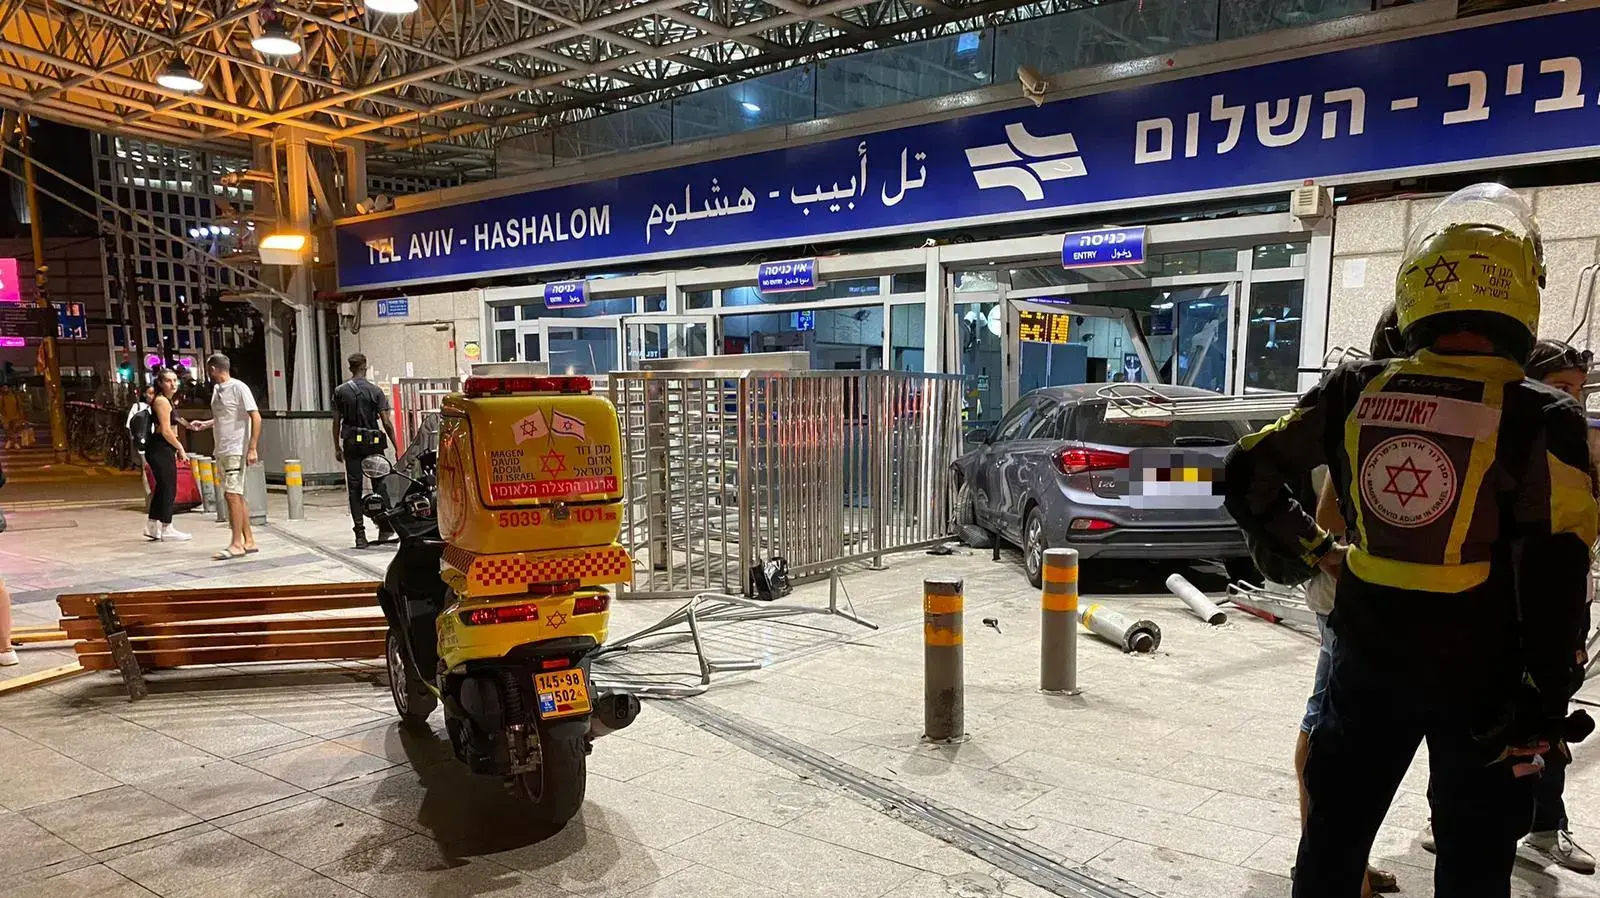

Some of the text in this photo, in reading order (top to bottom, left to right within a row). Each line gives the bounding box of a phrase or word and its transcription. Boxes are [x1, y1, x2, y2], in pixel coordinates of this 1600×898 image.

[1443, 56, 1600, 125] ביב
[1134, 86, 1366, 165] השלום
[790, 140, 868, 216] أبيب
[881, 146, 927, 207] تل
[646, 177, 756, 245] هشلوم
[365, 236, 401, 265] TEL
[408, 228, 454, 260] AVIV
[474, 204, 610, 252] HASHALOM
[1080, 232, 1127, 247] כניסה
[1073, 250, 1097, 260] ENTRY
[1111, 248, 1132, 259] دخول
[765, 263, 807, 276] אין כניסה
[1481, 264, 1497, 275] דוד
[552, 284, 576, 294] כניסה
[1489, 276, 1511, 289] אדום
[1473, 283, 1509, 300] בישראל
[1356, 396, 1439, 425] האופנועים
[490, 449, 524, 458] MAGEN
[576, 445, 611, 456] מגן דוד
[491, 458, 520, 466] DAVID
[587, 455, 612, 465] אדום
[1368, 441, 1448, 479] מגן דוד אדום בישראל
[492, 466, 521, 474] ADOM
[493, 473, 536, 482] IN ISRAEL
[573, 466, 613, 477] בישראל
[494, 480, 614, 497] ארגון ההצלה הלאומי
[1367, 479, 1380, 505] MAGEN
[1377, 503, 1398, 520] DAVID
[1423, 510, 1432, 518] IN
[1431, 490, 1449, 511] ISRAEL
[500, 511, 541, 528] 5039
[573, 508, 604, 523] 101
[539, 673, 579, 690] 145-98
[555, 689, 577, 703] 502
